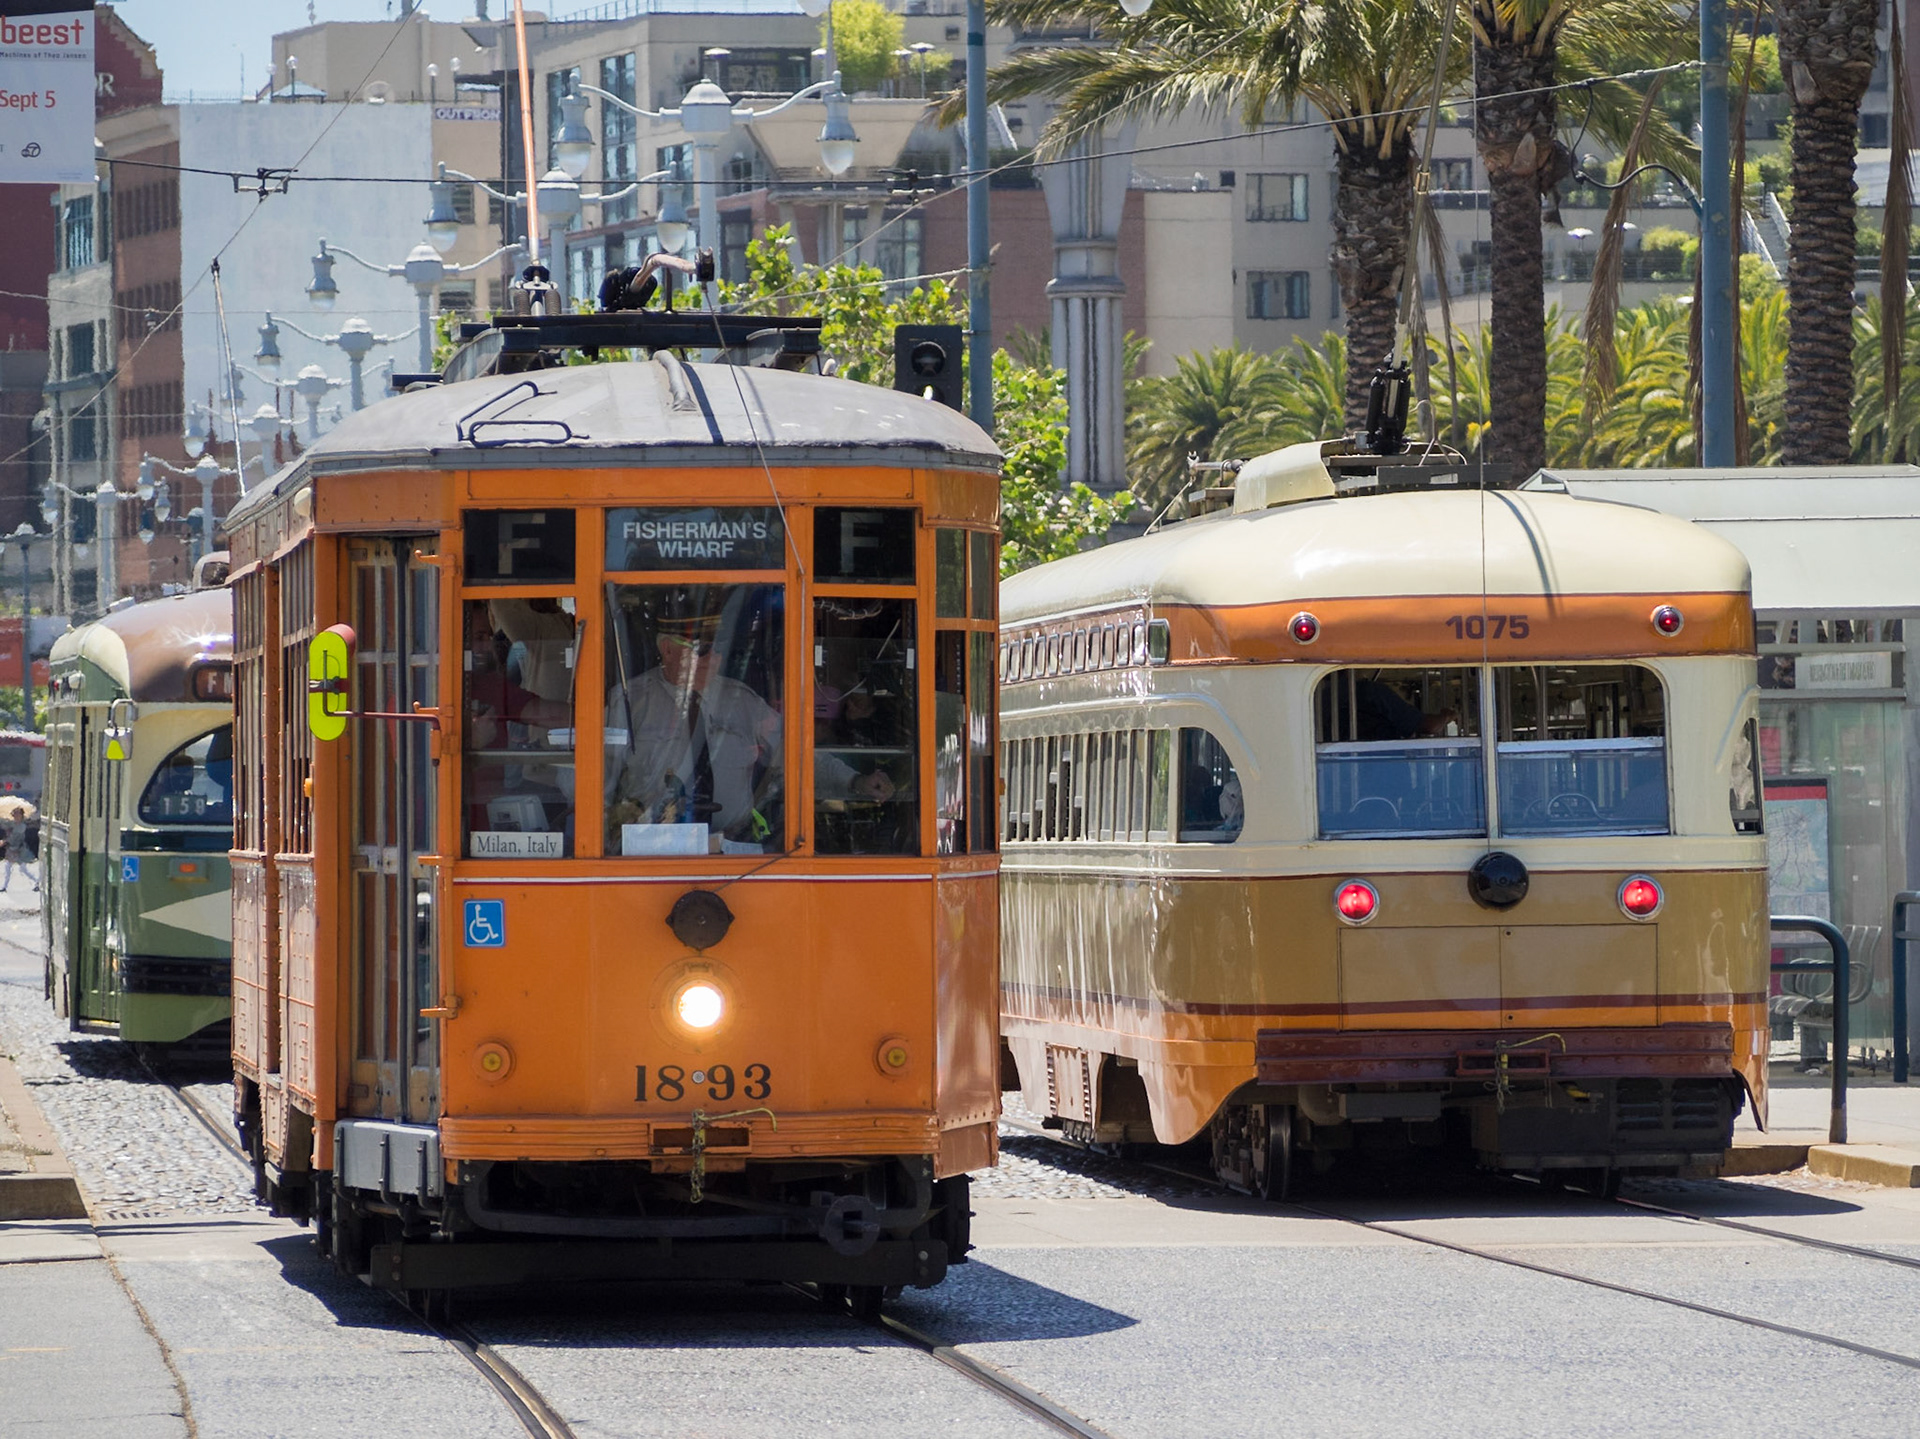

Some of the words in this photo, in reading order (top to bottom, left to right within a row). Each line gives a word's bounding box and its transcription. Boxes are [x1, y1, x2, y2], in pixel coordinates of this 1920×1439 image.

[0, 90, 38, 112] Sept
[45, 90, 56, 109] 5
[622, 521, 767, 540] FISHERMAN'S
[840, 511, 884, 573] F
[498, 512, 545, 574] F
[657, 541, 735, 558] WHARF
[1445, 614, 1530, 640] 1075
[207, 671, 218, 694] F
[476, 835, 522, 855] Milan,
[527, 835, 558, 855] Italy
[633, 1063, 772, 1103] 1893
